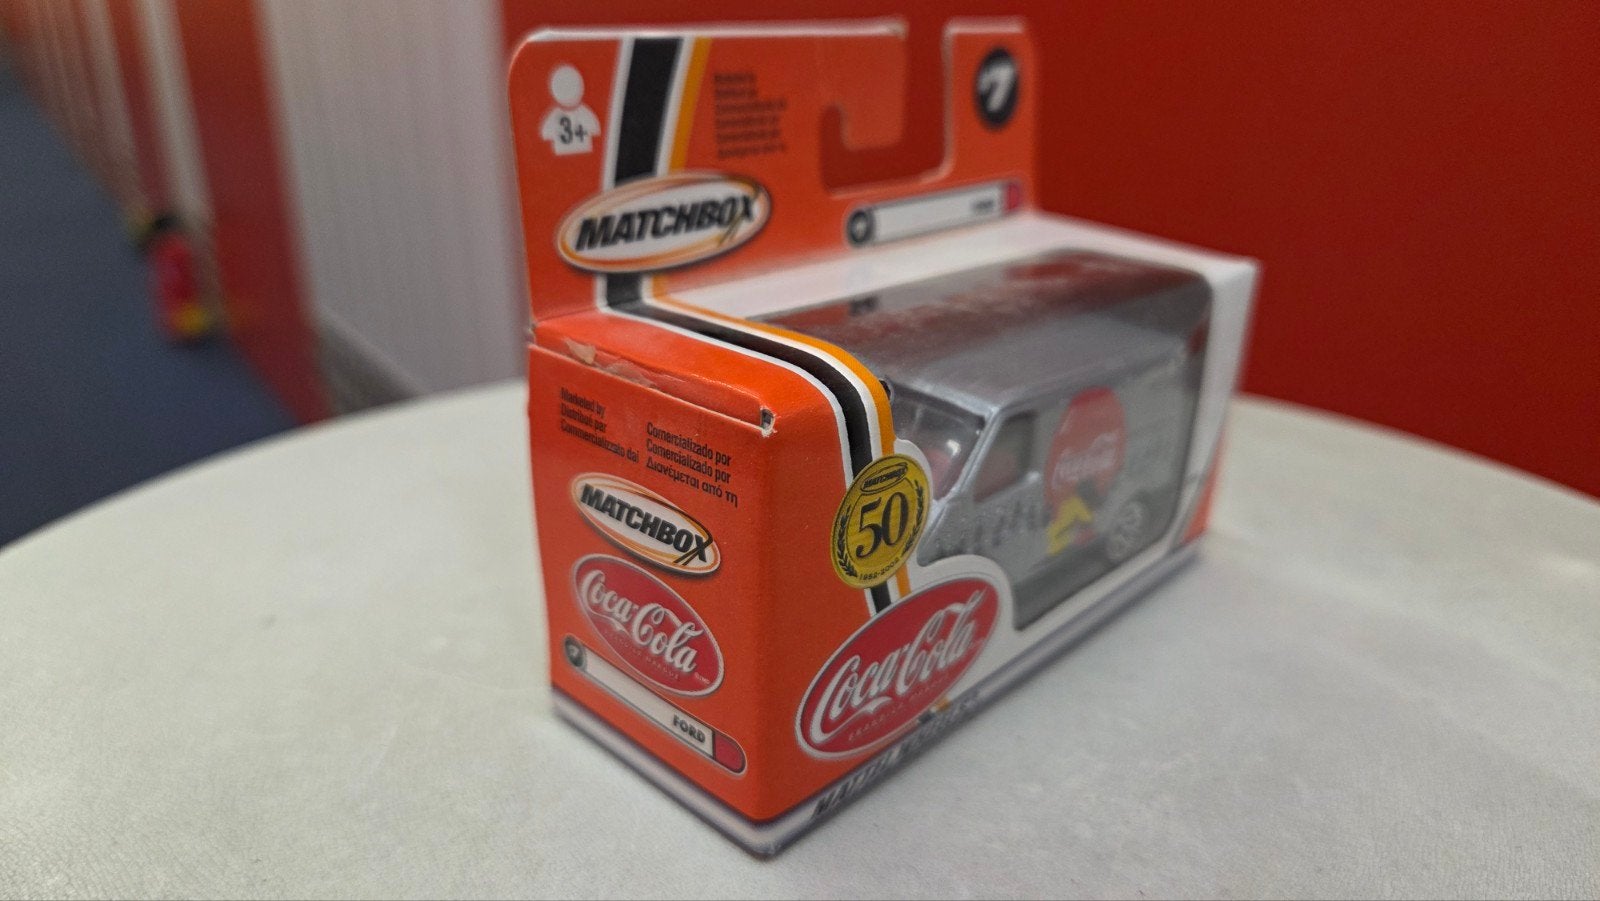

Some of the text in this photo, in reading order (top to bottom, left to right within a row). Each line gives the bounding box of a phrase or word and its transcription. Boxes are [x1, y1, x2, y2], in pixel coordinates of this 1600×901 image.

[559, 116, 588, 145] 3+
[575, 195, 757, 251] MATCHBOX
[646, 421, 732, 466] Comercializado por
[646, 438, 732, 484] Comercializado por
[646, 456, 739, 509] Διανέμεται από τη
[580, 483, 713, 564] MATCHBOX
[856, 491, 909, 559] 50
[580, 569, 705, 673] Coca-Cola
[810, 588, 986, 744] Coca-Cola
[672, 713, 706, 744] FORD
